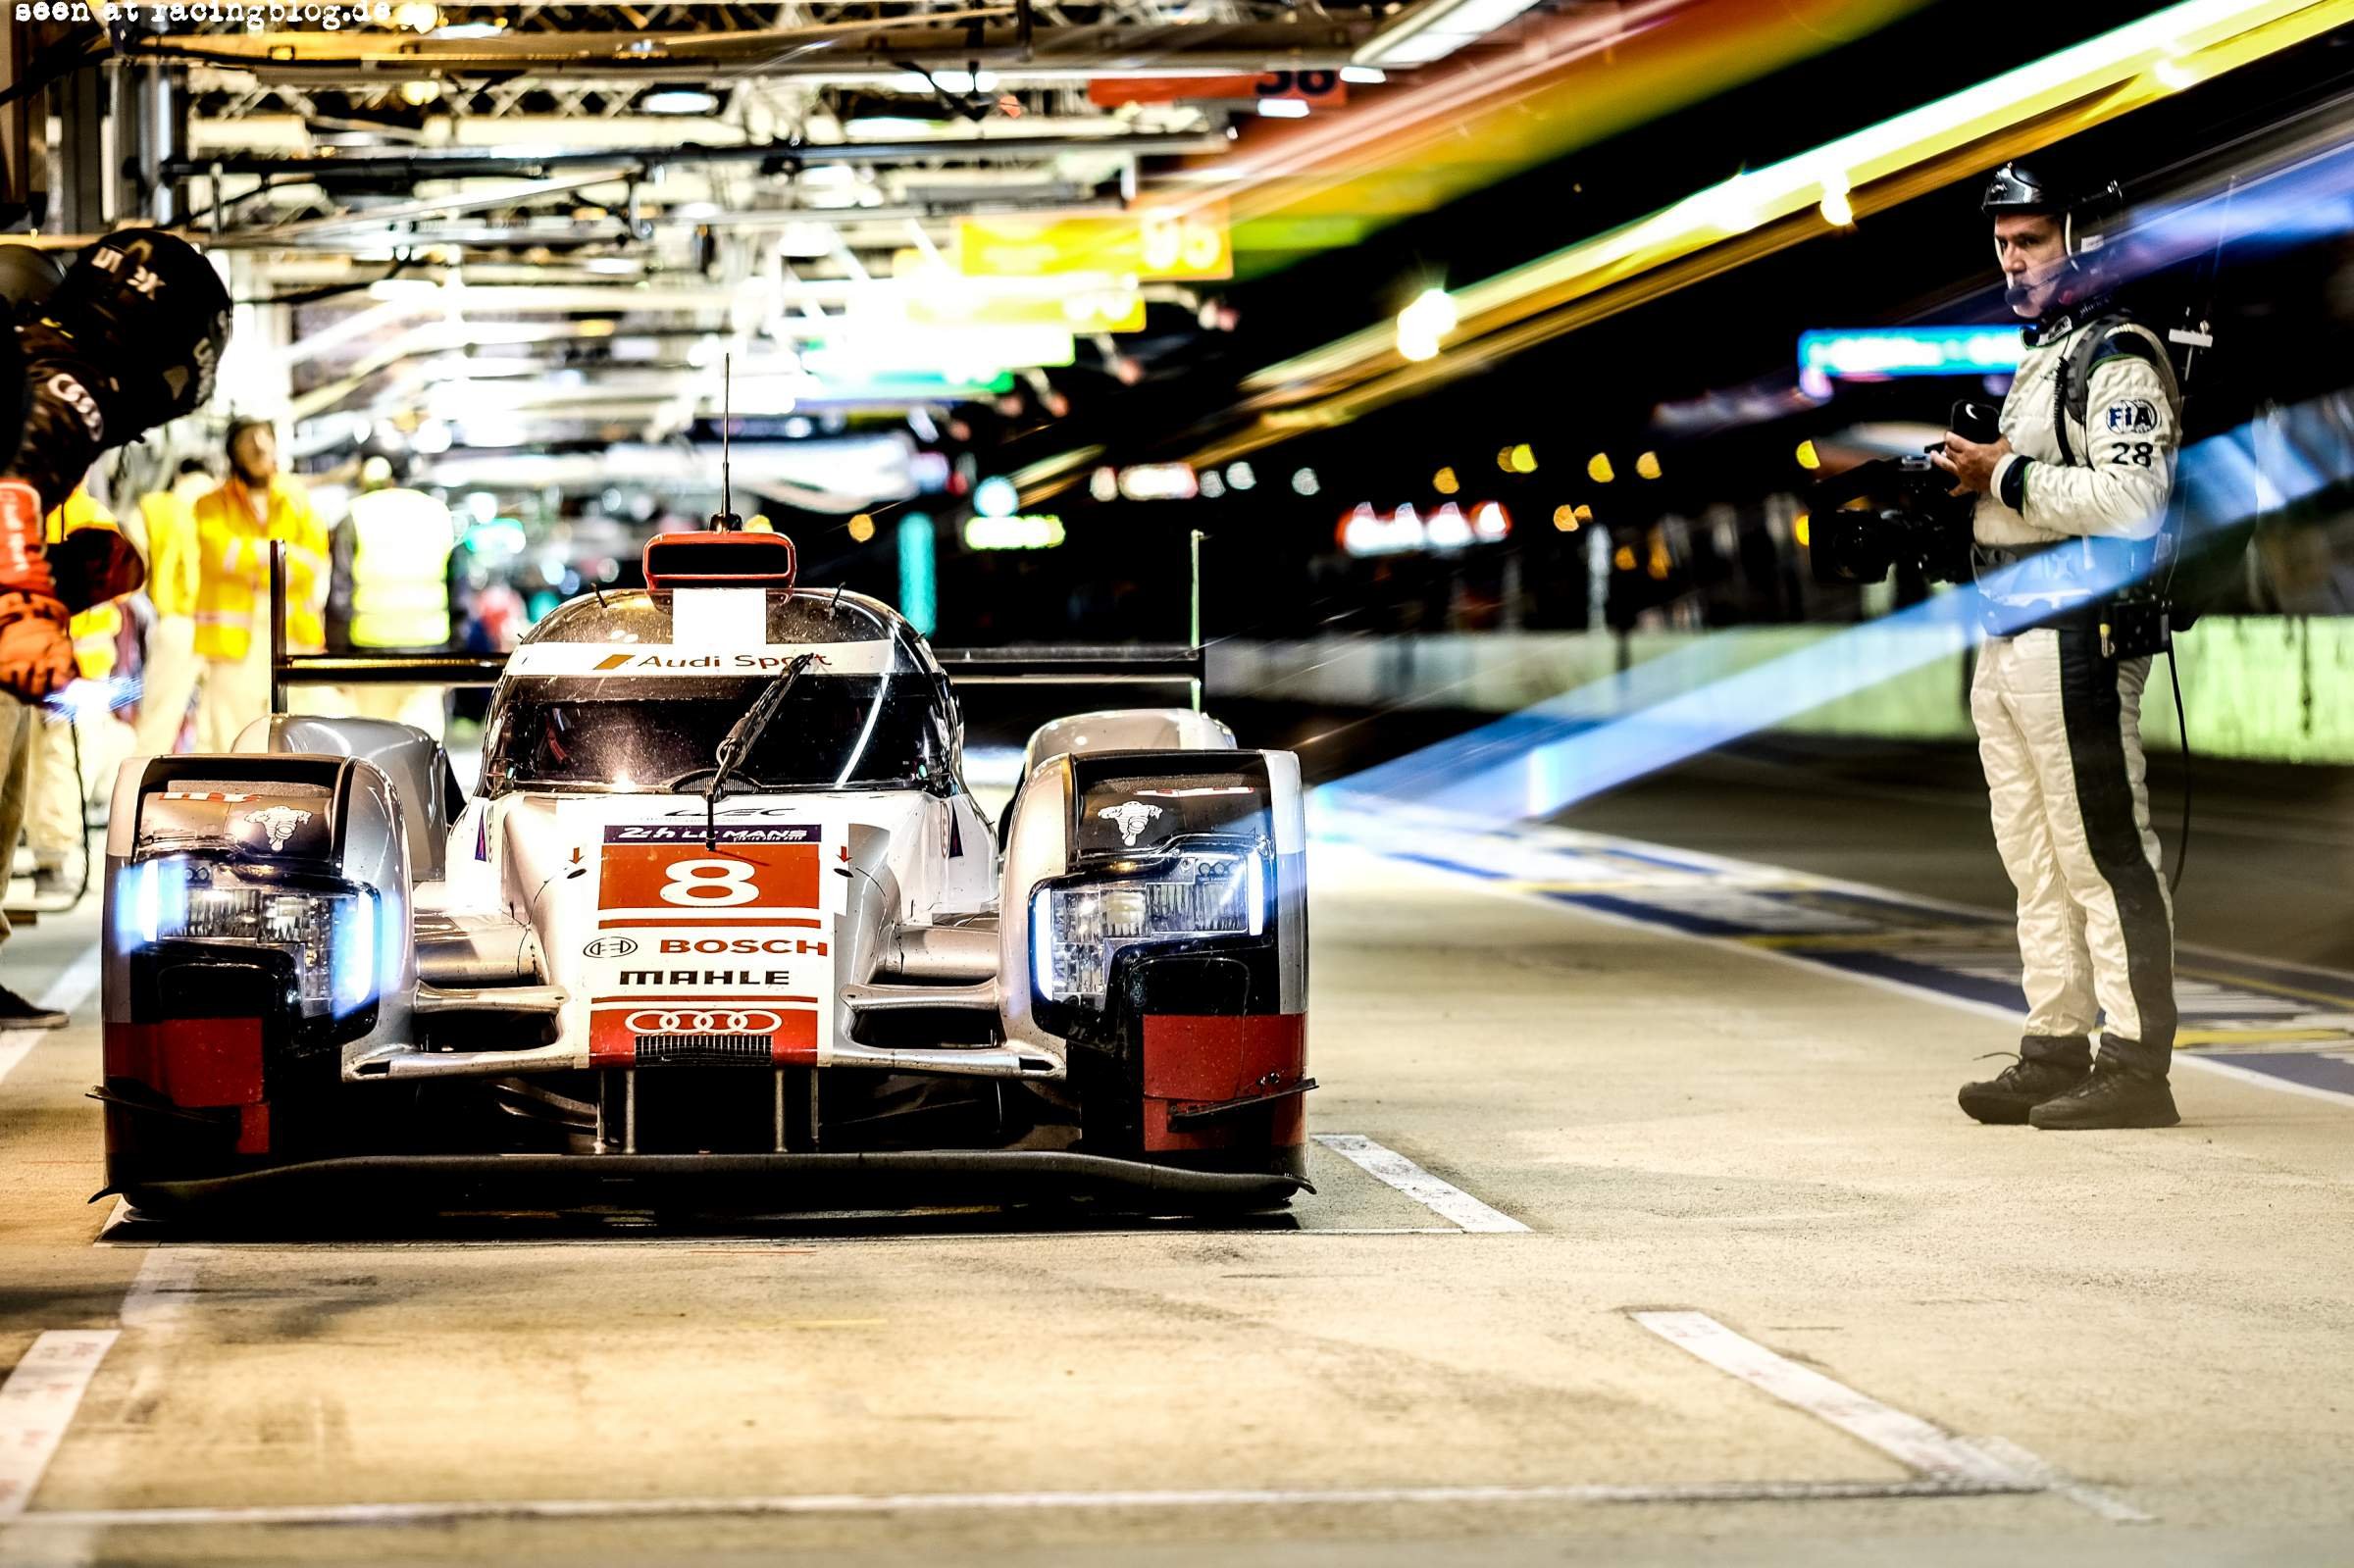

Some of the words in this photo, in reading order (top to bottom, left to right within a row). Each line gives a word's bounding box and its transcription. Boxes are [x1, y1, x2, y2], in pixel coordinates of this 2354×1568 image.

[2108, 406, 2152, 428] FIA
[2111, 441, 2154, 468] 28
[638, 654, 721, 668] Audi
[735, 654, 833, 670] Spot
[659, 858, 760, 907] 8
[660, 938, 828, 957] BOSCH
[619, 970, 790, 986] MAHLE
